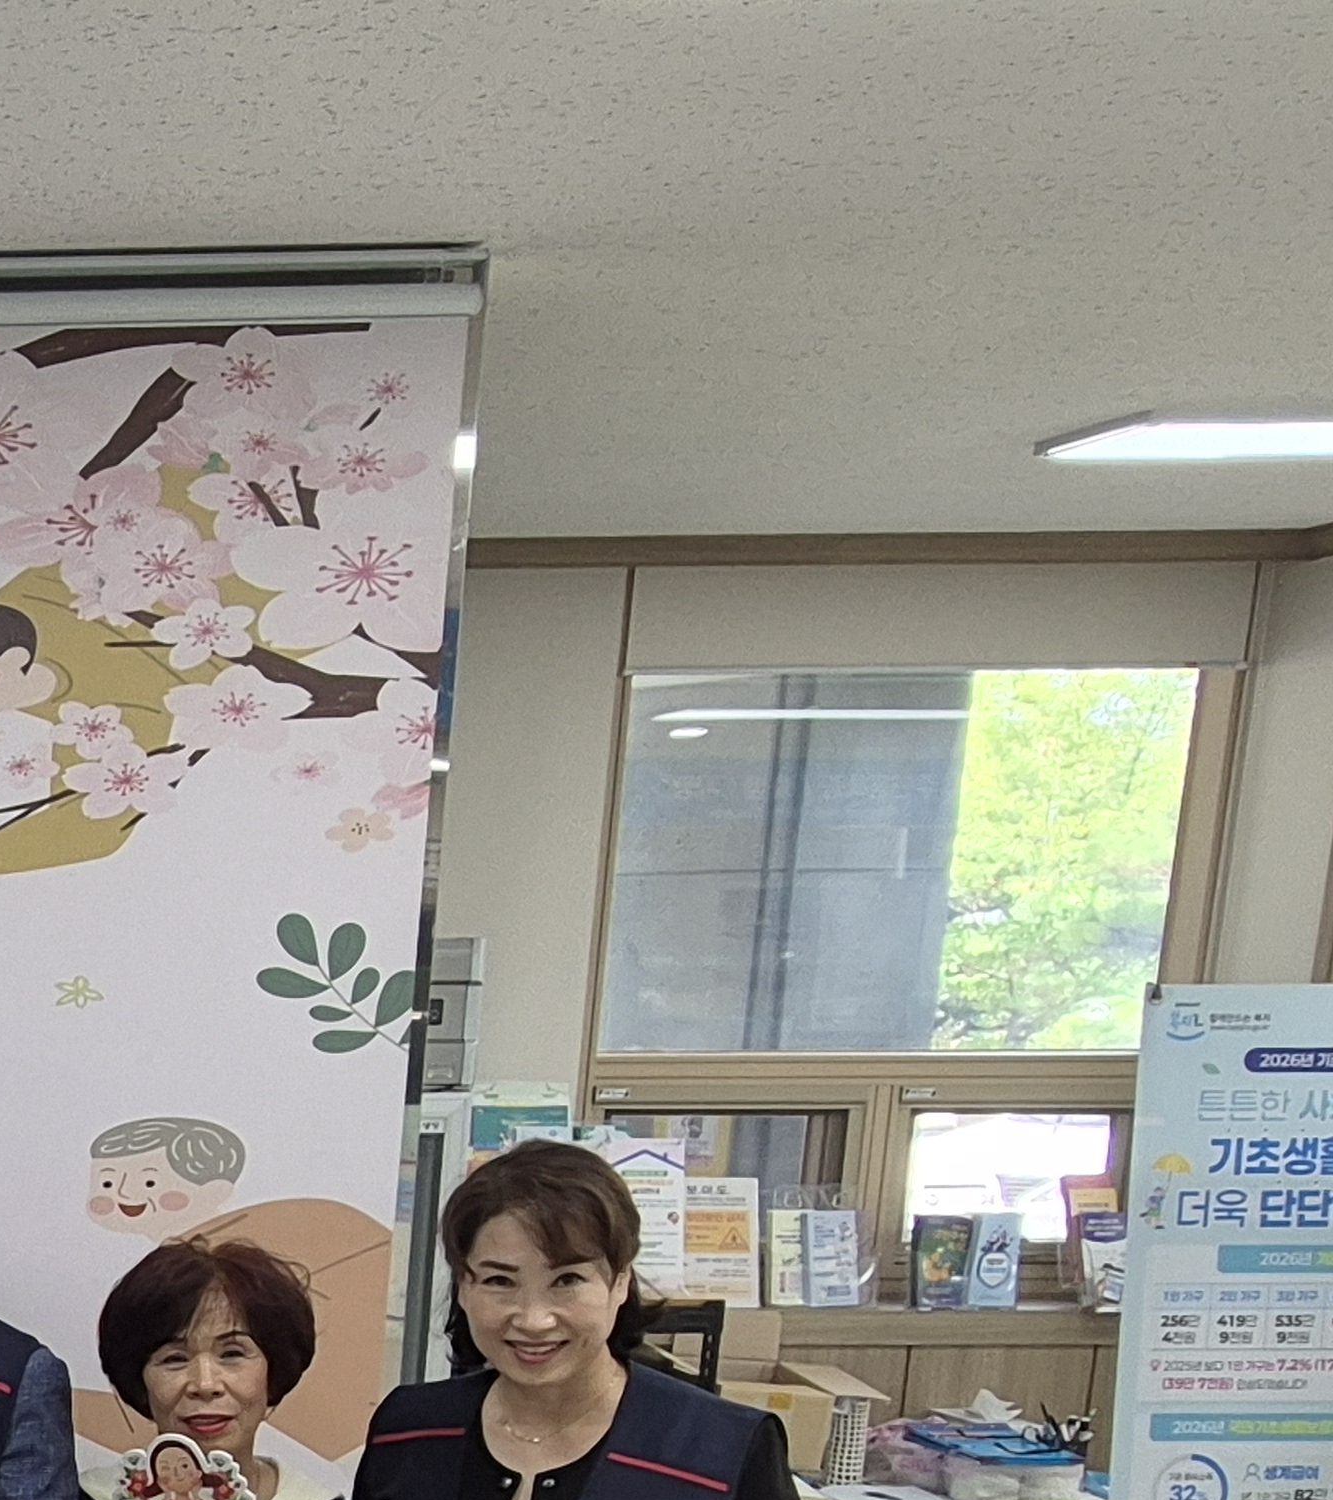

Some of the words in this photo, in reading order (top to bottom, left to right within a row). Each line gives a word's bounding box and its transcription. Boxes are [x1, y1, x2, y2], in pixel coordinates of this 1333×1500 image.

[1259, 1053, 1314, 1068] 2026년
[1198, 1089, 1292, 1121] 튼튼한
[1299, 1089, 1333, 1121] 사
[1177, 1189, 1248, 1228] 더욱
